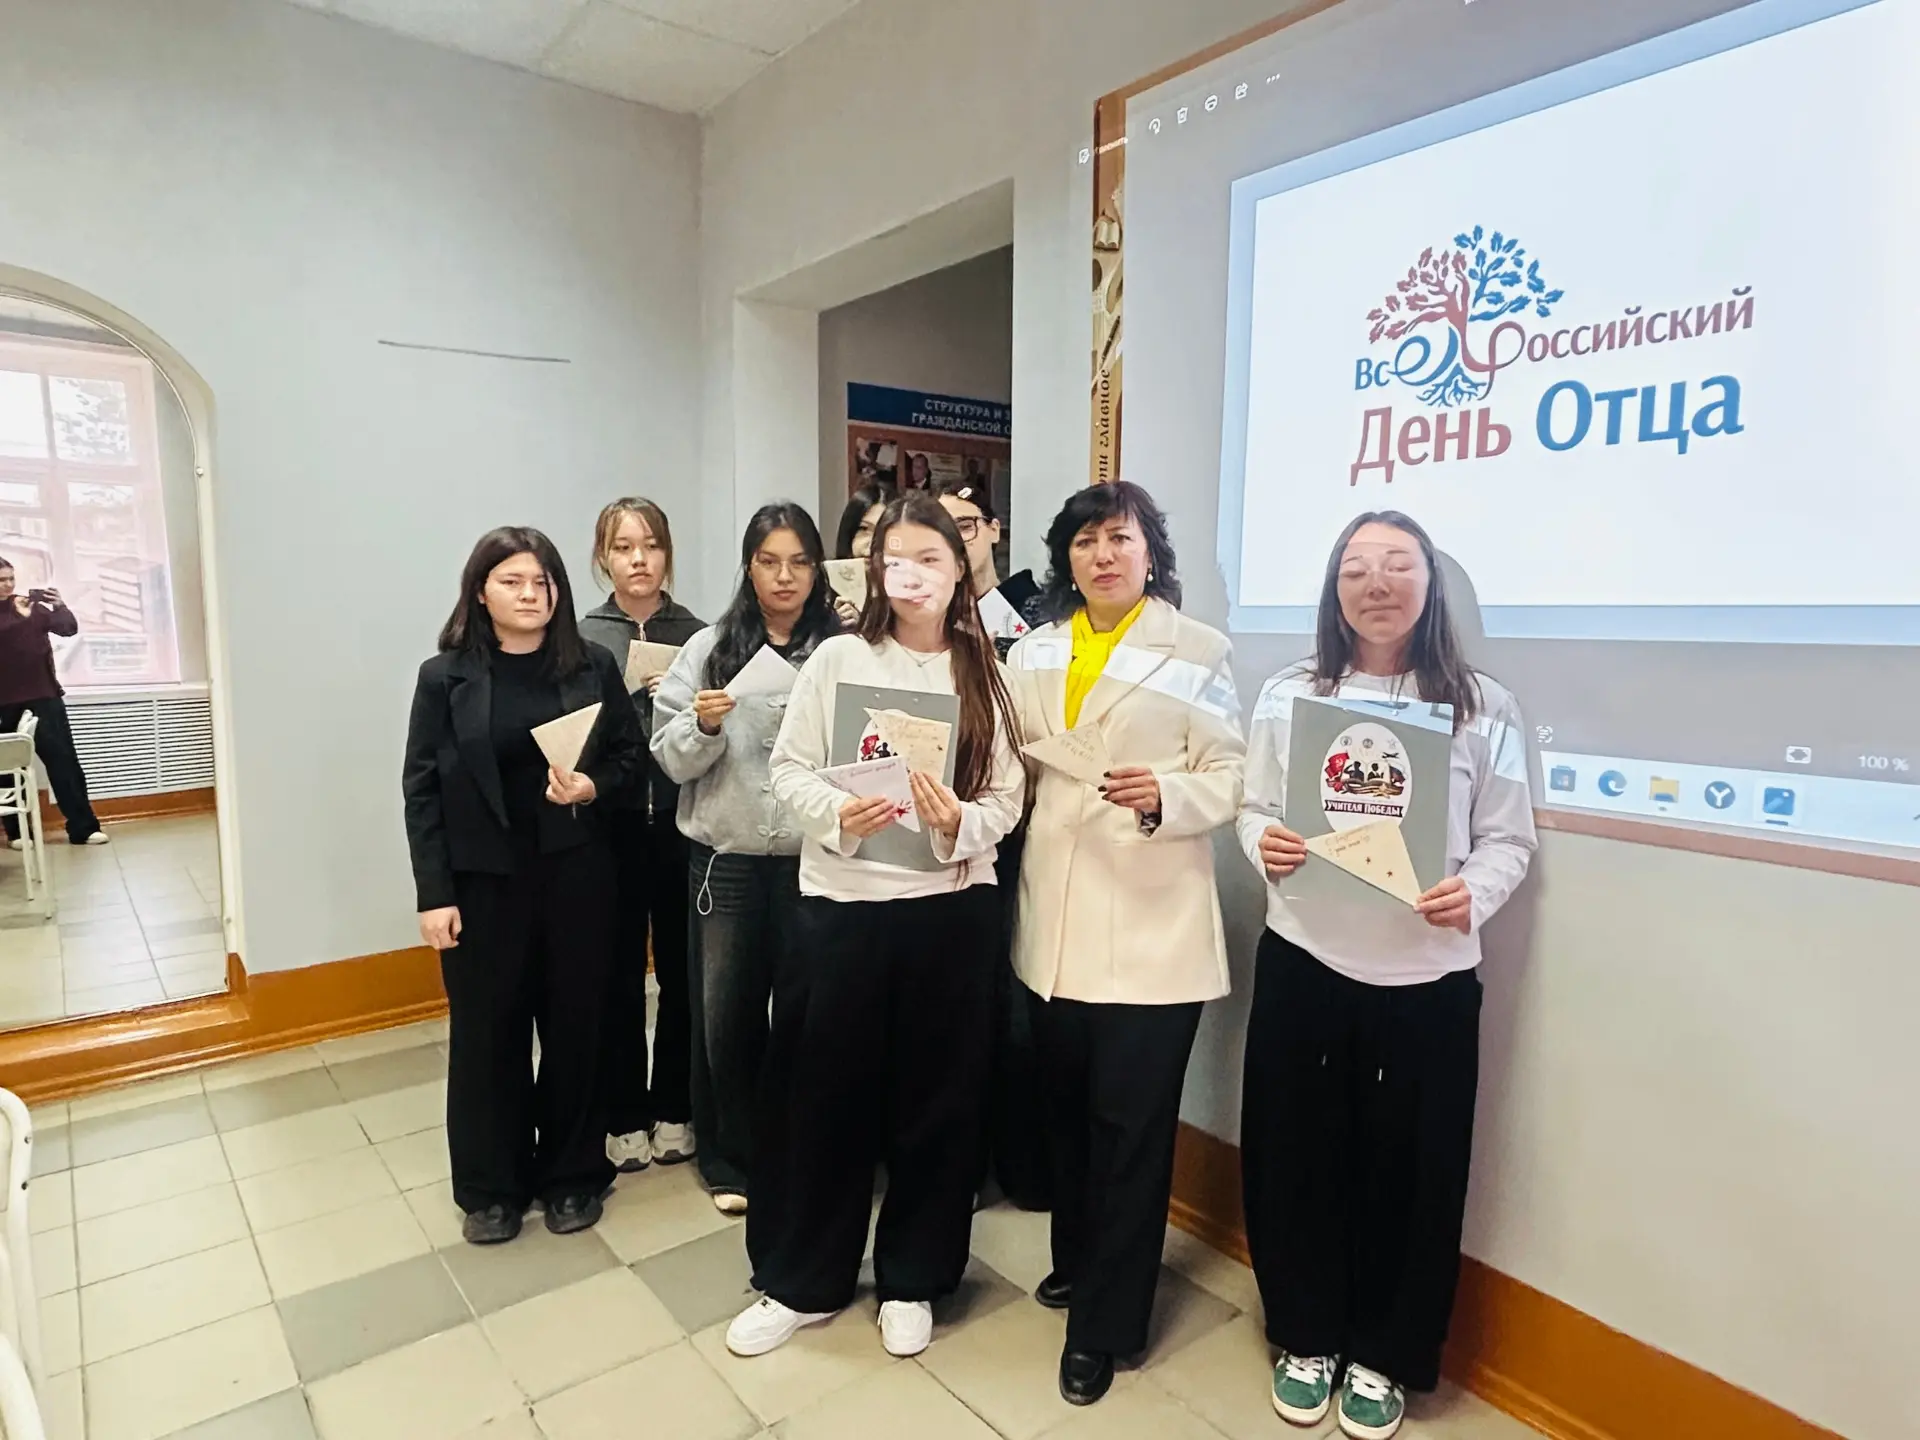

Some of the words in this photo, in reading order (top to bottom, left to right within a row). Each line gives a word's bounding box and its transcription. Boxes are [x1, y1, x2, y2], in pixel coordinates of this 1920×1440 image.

[924, 399, 991, 419] СТРУКТУРА
[1099, 369, 1111, 448] главное
[911, 412, 1001, 434] ГРАЖДАНСКОЙ
[1350, 405, 1513, 487] День
[1536, 374, 1745, 456] Отца
[1857, 755, 1889, 769] 100
[1892, 757, 1910, 771] %
[1327, 801, 1363, 813] УЧИТЕЛЯ
[1364, 803, 1401, 816] ПОБЕДЫ
